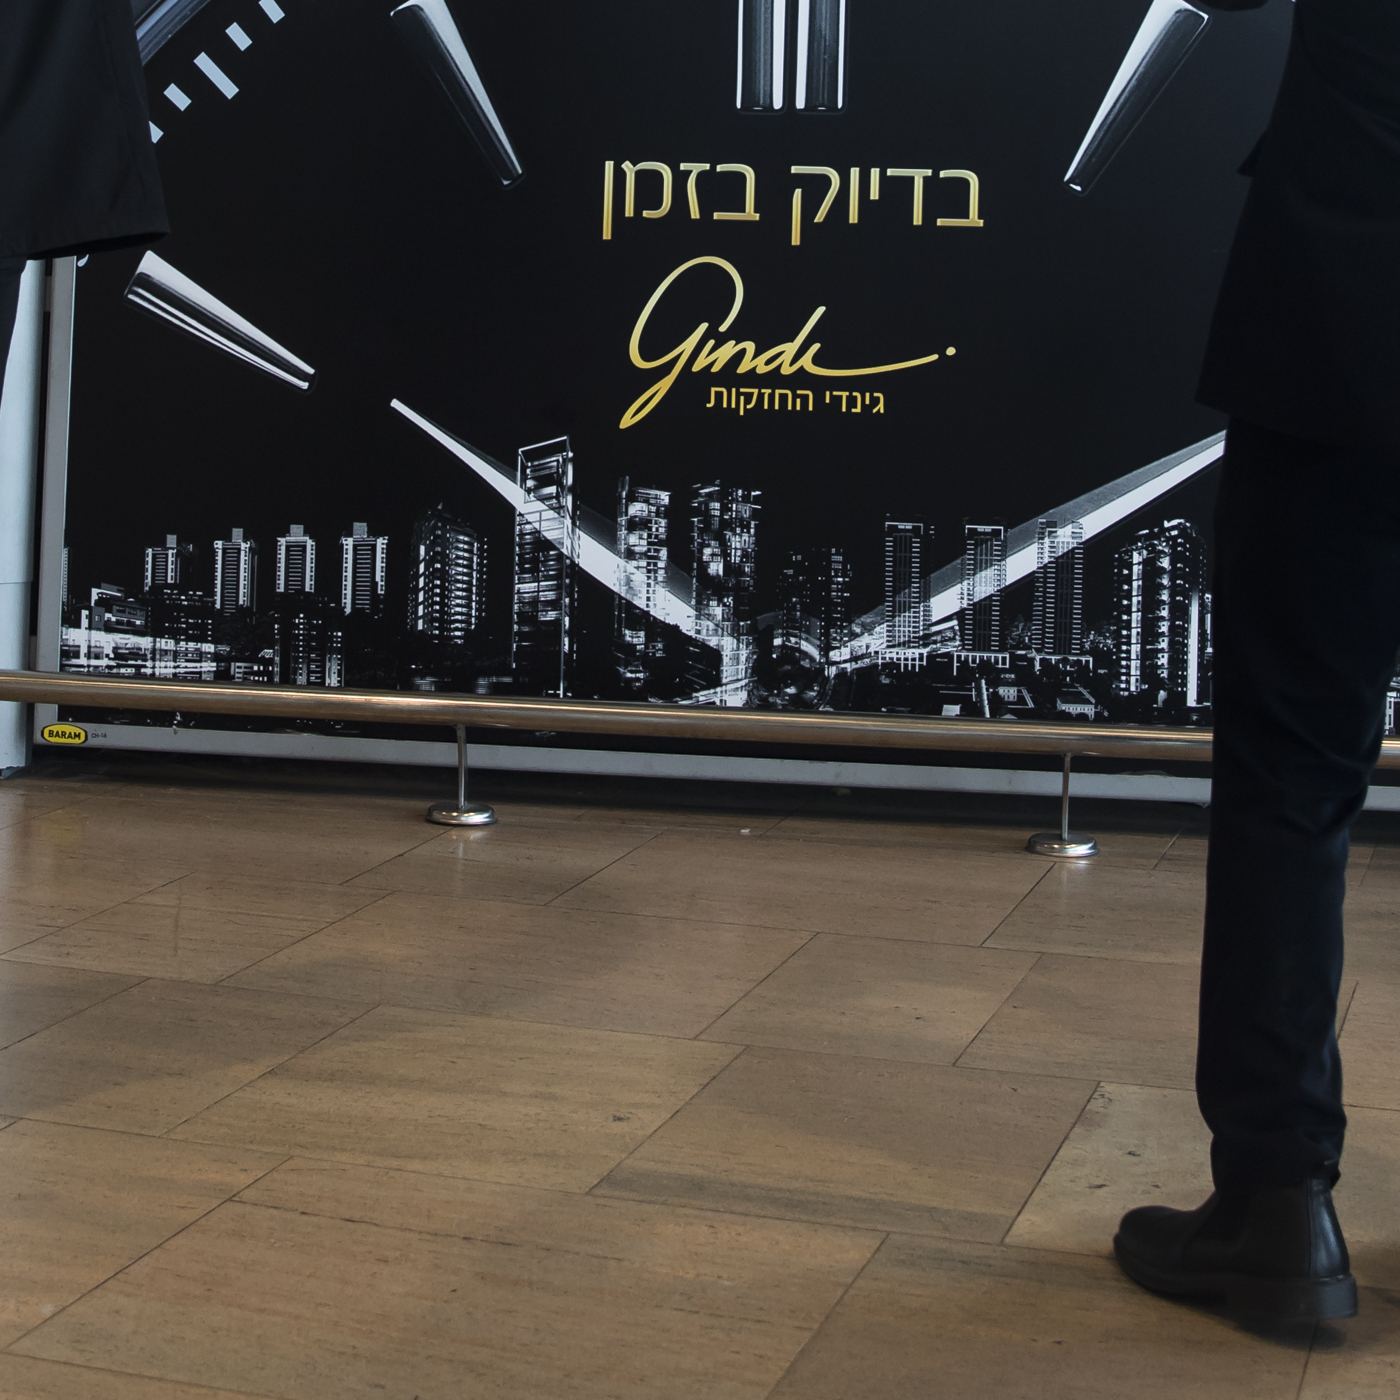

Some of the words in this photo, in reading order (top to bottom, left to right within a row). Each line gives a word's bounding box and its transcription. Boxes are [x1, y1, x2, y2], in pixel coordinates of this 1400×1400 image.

[602, 160, 761, 240] בזמן
[790, 165, 985, 246] בדיוק
[705, 386, 814, 416] החזקות
[825, 390, 885, 415] גינדי
[48, 729, 82, 741] BARAM
